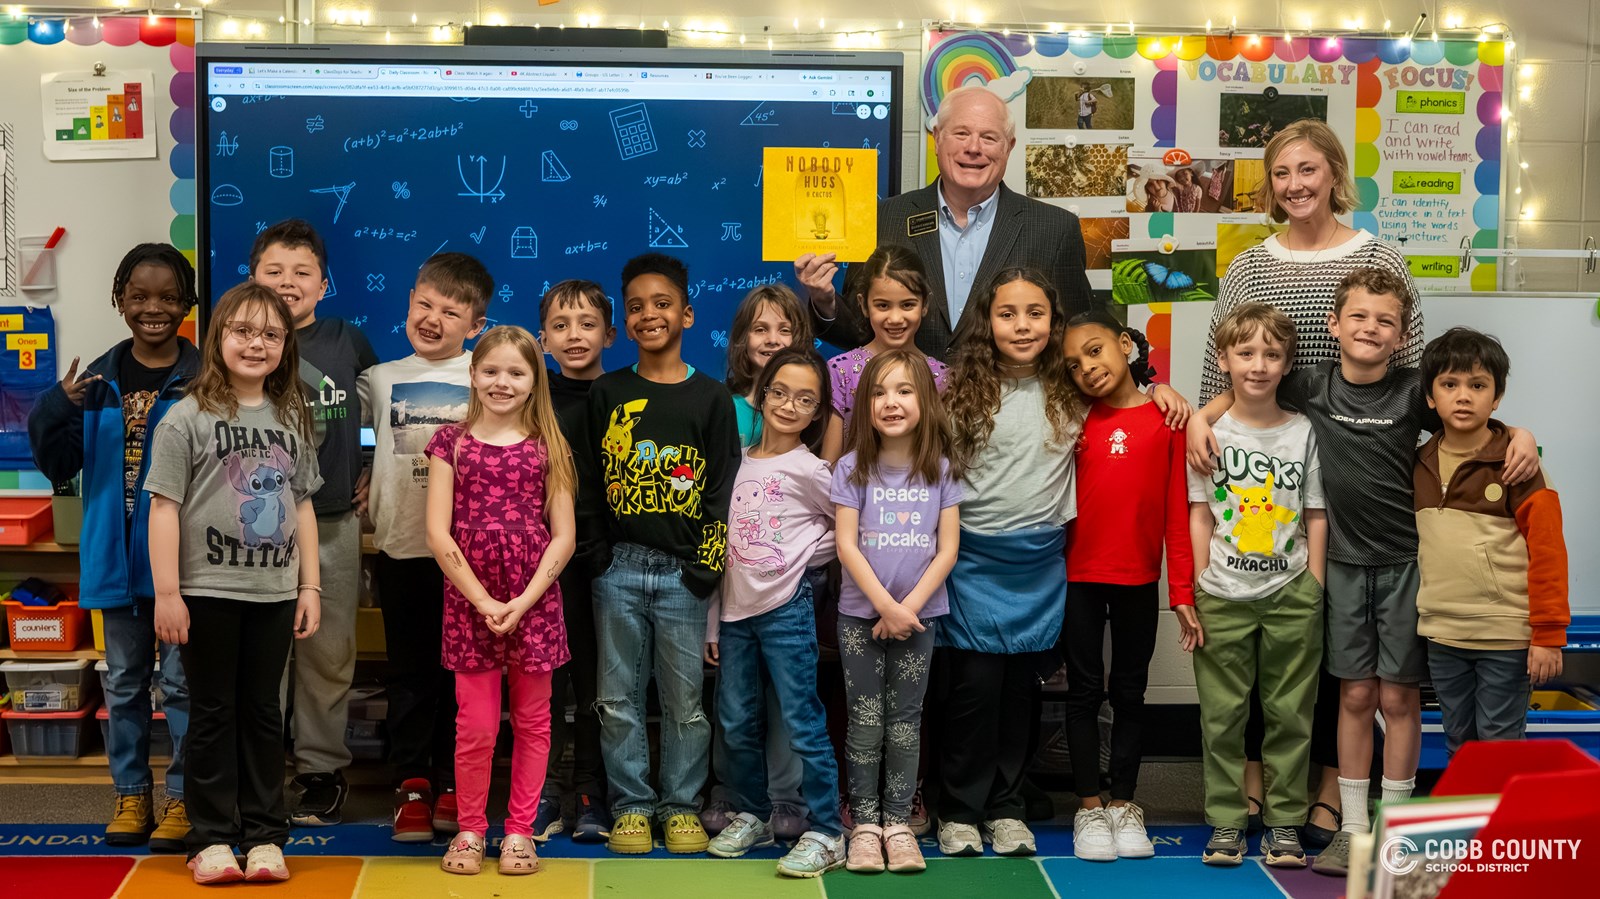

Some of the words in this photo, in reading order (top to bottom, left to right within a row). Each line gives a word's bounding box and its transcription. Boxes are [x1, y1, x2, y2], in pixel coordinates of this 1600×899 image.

[1182, 60, 1356, 85] VOCABULARY
[1383, 66, 1475, 92] FOCUS!
[1420, 97, 1458, 109] phonics
[1385, 118, 1400, 134] I
[1404, 121, 1429, 134] can
[1433, 121, 1460, 137] read
[1385, 134, 1411, 148] and
[1415, 136, 1455, 149] write
[1383, 149, 1414, 161] with
[1417, 150, 1447, 162] vowel
[786, 155, 854, 174] NOBODY
[804, 175, 836, 189] HUGS
[1416, 179, 1455, 191] reading
[1380, 197, 1390, 208] I
[1412, 197, 1450, 210] identify
[1378, 209, 1418, 219] evidence
[1447, 209, 1467, 218] text
[1381, 220, 1407, 234] using
[1412, 219, 1427, 231] the
[1431, 220, 1459, 231] words
[1421, 261, 1453, 274] writing
[17, 336, 38, 346] Ones
[21, 351, 34, 367] 3
[1328, 413, 1355, 424] UNDER
[1355, 417, 1394, 425] ARMOUR
[214, 420, 299, 464] OHANA
[873, 487, 930, 505] peace
[206, 525, 297, 568] STITCH
[1226, 555, 1289, 572] PIKACHU
[21, 624, 58, 633] counters
